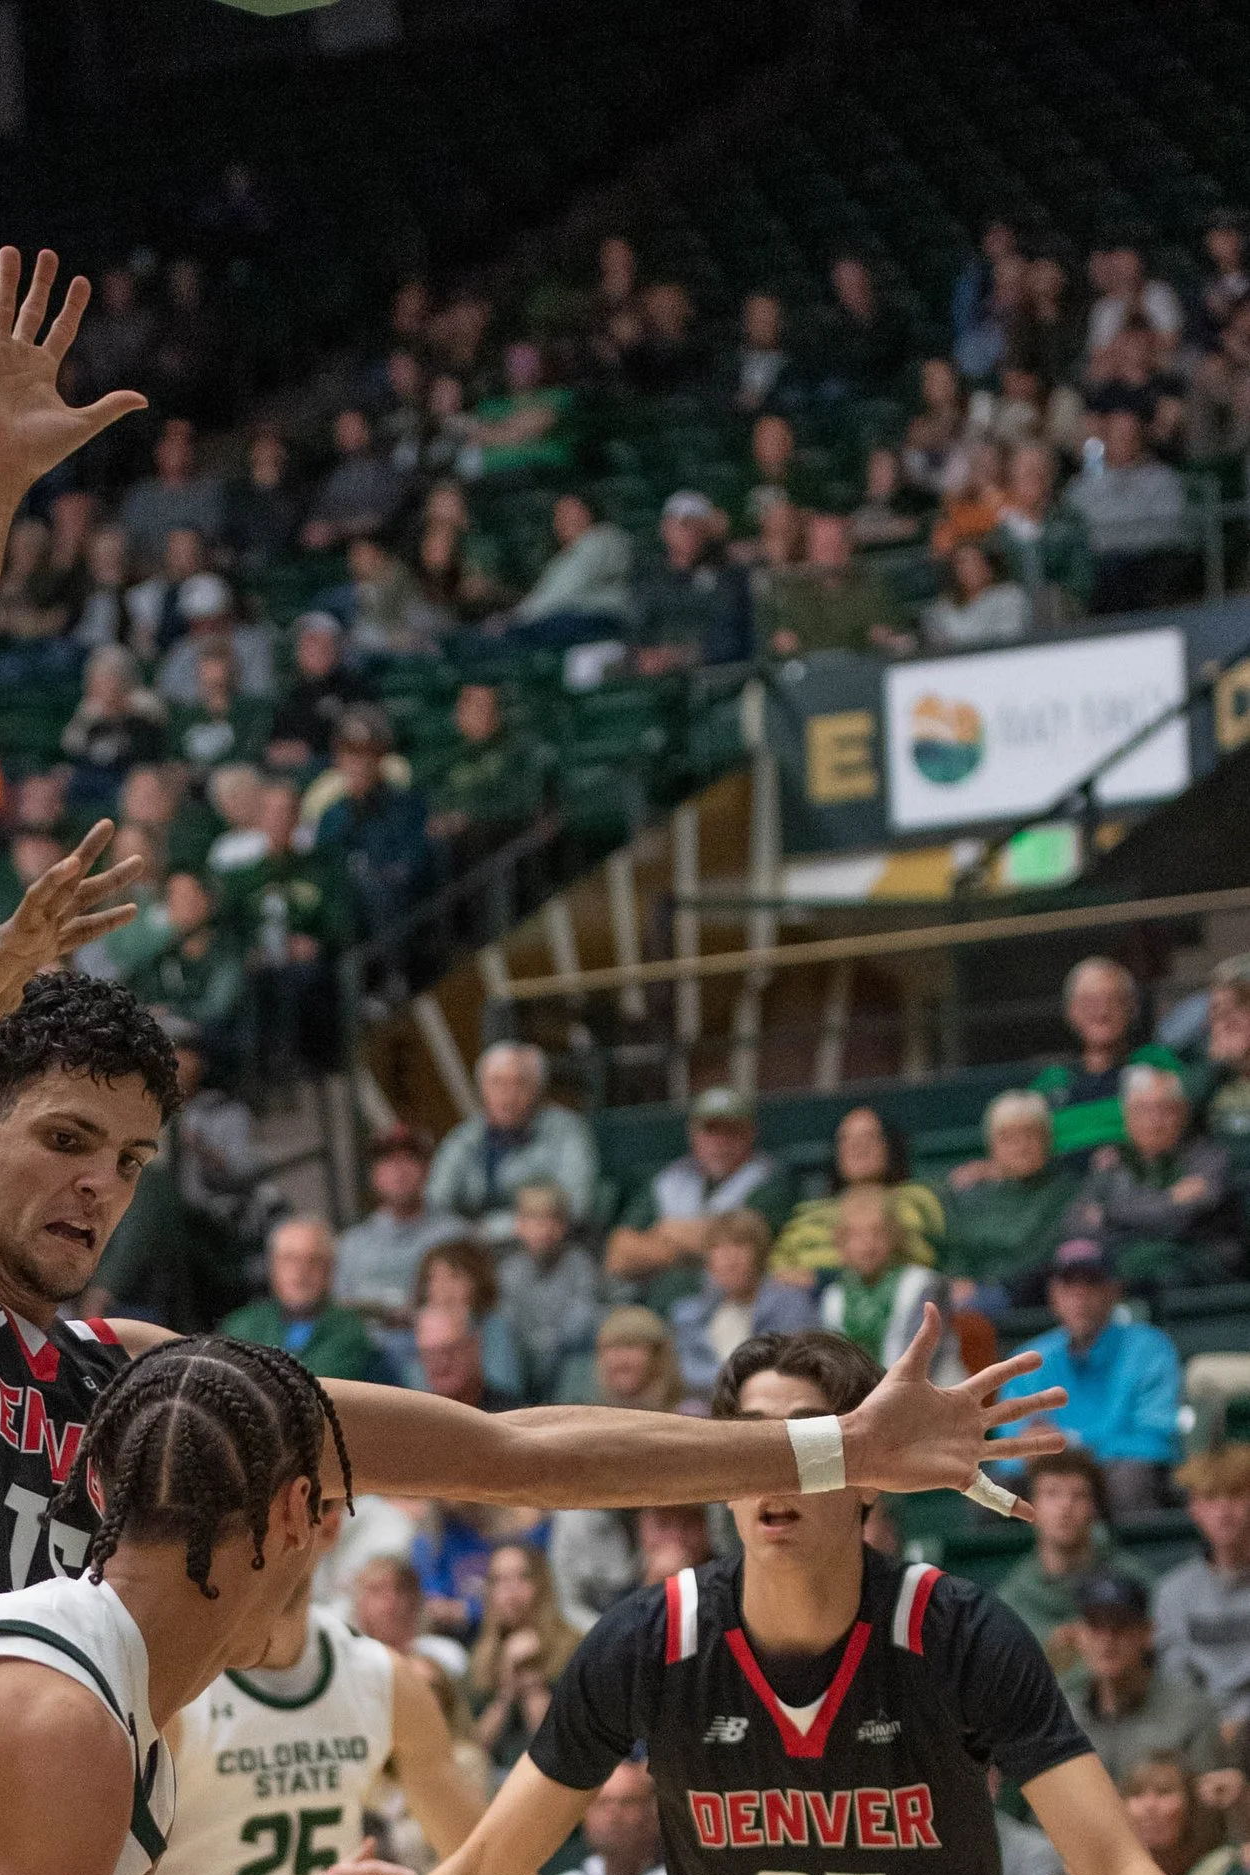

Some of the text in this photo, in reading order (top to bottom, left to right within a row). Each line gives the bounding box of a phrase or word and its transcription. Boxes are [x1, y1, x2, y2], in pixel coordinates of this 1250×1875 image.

[805, 711, 878, 805] E
[216, 1735, 369, 1775] COLORADO
[255, 1764, 341, 1798] STATE
[688, 1782, 942, 1849] DENVER
